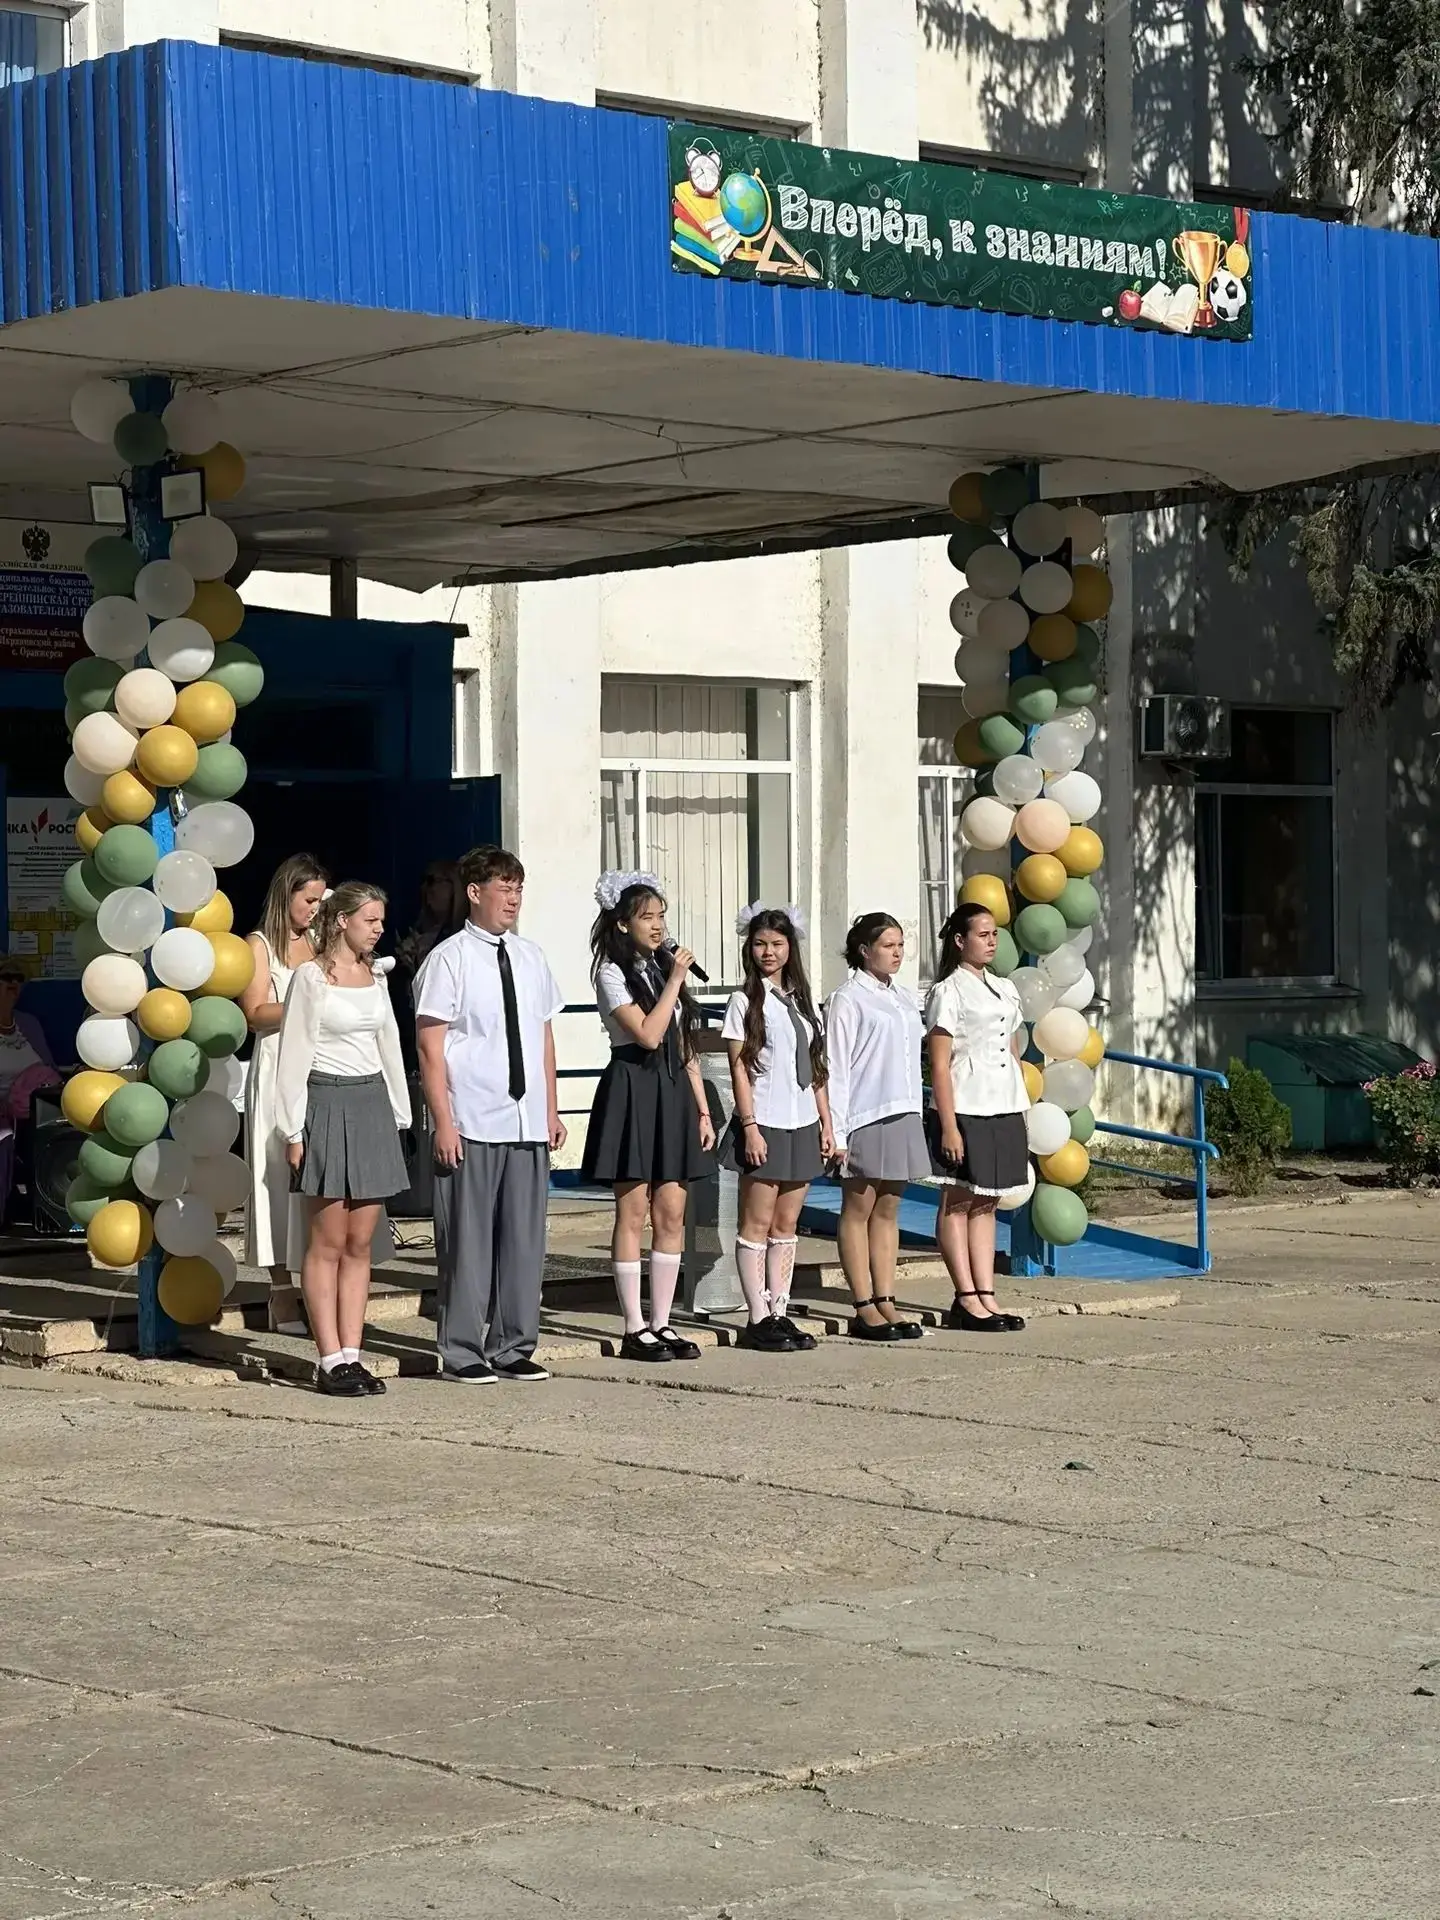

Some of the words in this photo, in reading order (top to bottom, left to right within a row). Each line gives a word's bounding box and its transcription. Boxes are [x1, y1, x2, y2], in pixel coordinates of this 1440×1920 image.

[778, 185, 943, 261] Вперёд,
[949, 219, 978, 255] к
[985, 224, 1167, 280] знаниям!
